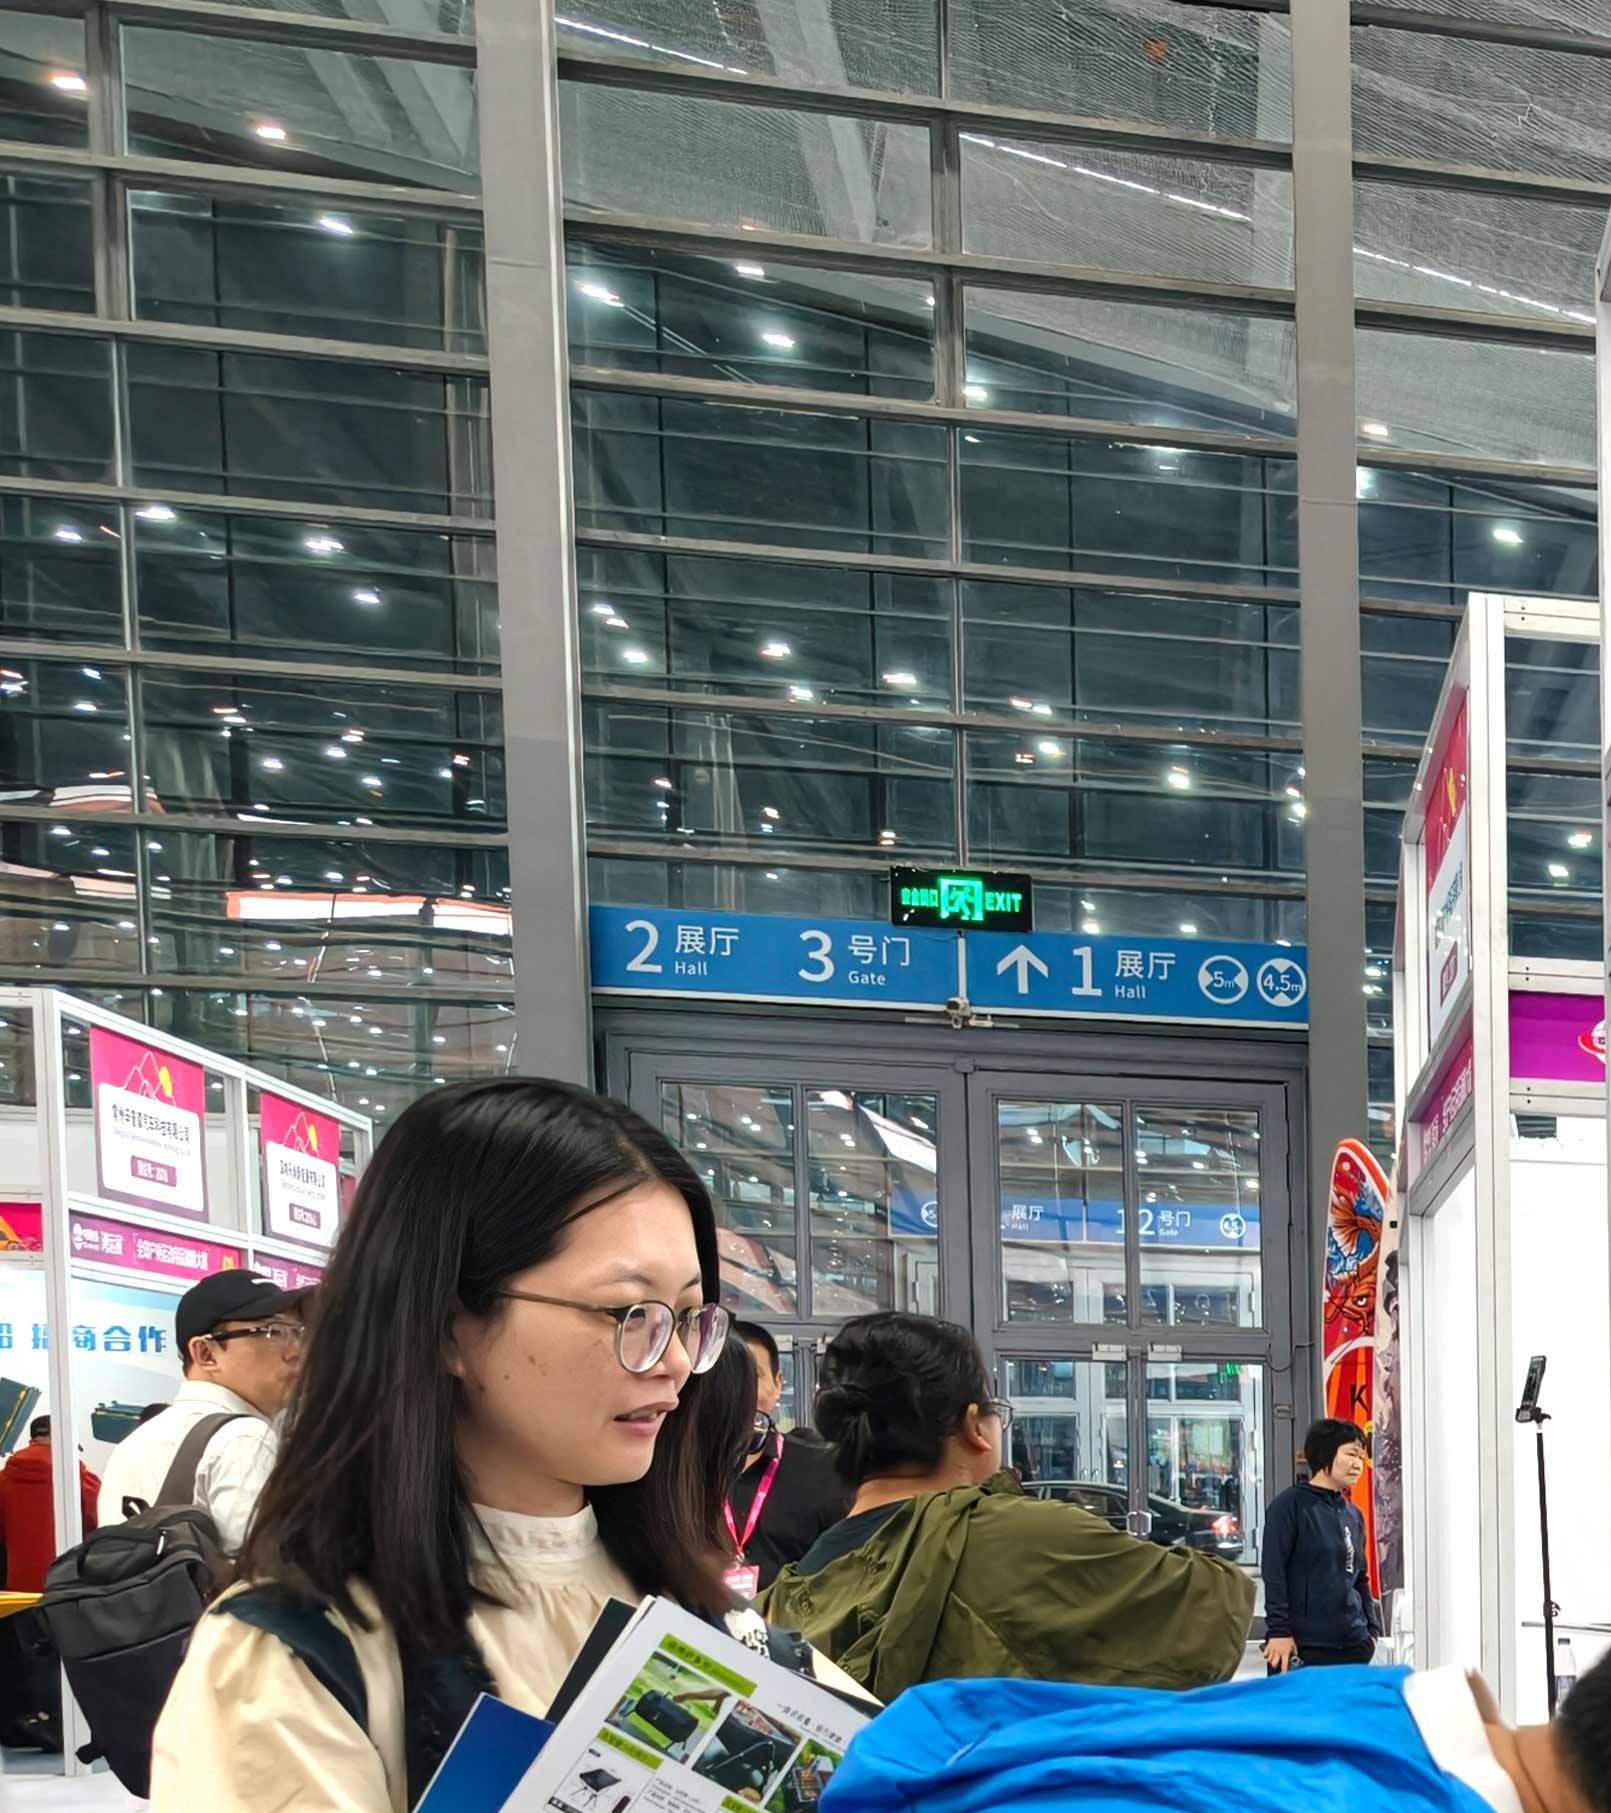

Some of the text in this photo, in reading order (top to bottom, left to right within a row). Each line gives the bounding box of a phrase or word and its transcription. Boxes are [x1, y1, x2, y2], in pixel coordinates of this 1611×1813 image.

[985, 892, 1022, 912] EXIT
[624, 919, 663, 974] 2
[674, 924, 740, 958] 展厅
[797, 928, 835, 984] 3
[846, 934, 912, 968] 号门
[1070, 945, 1103, 998] 1
[1114, 949, 1177, 981] 展厅
[673, 957, 1148, 1001] Hall Gate Hall
[1011, 1204, 1044, 1222] 展厅
[1158, 1210, 1191, 1227] 号门
